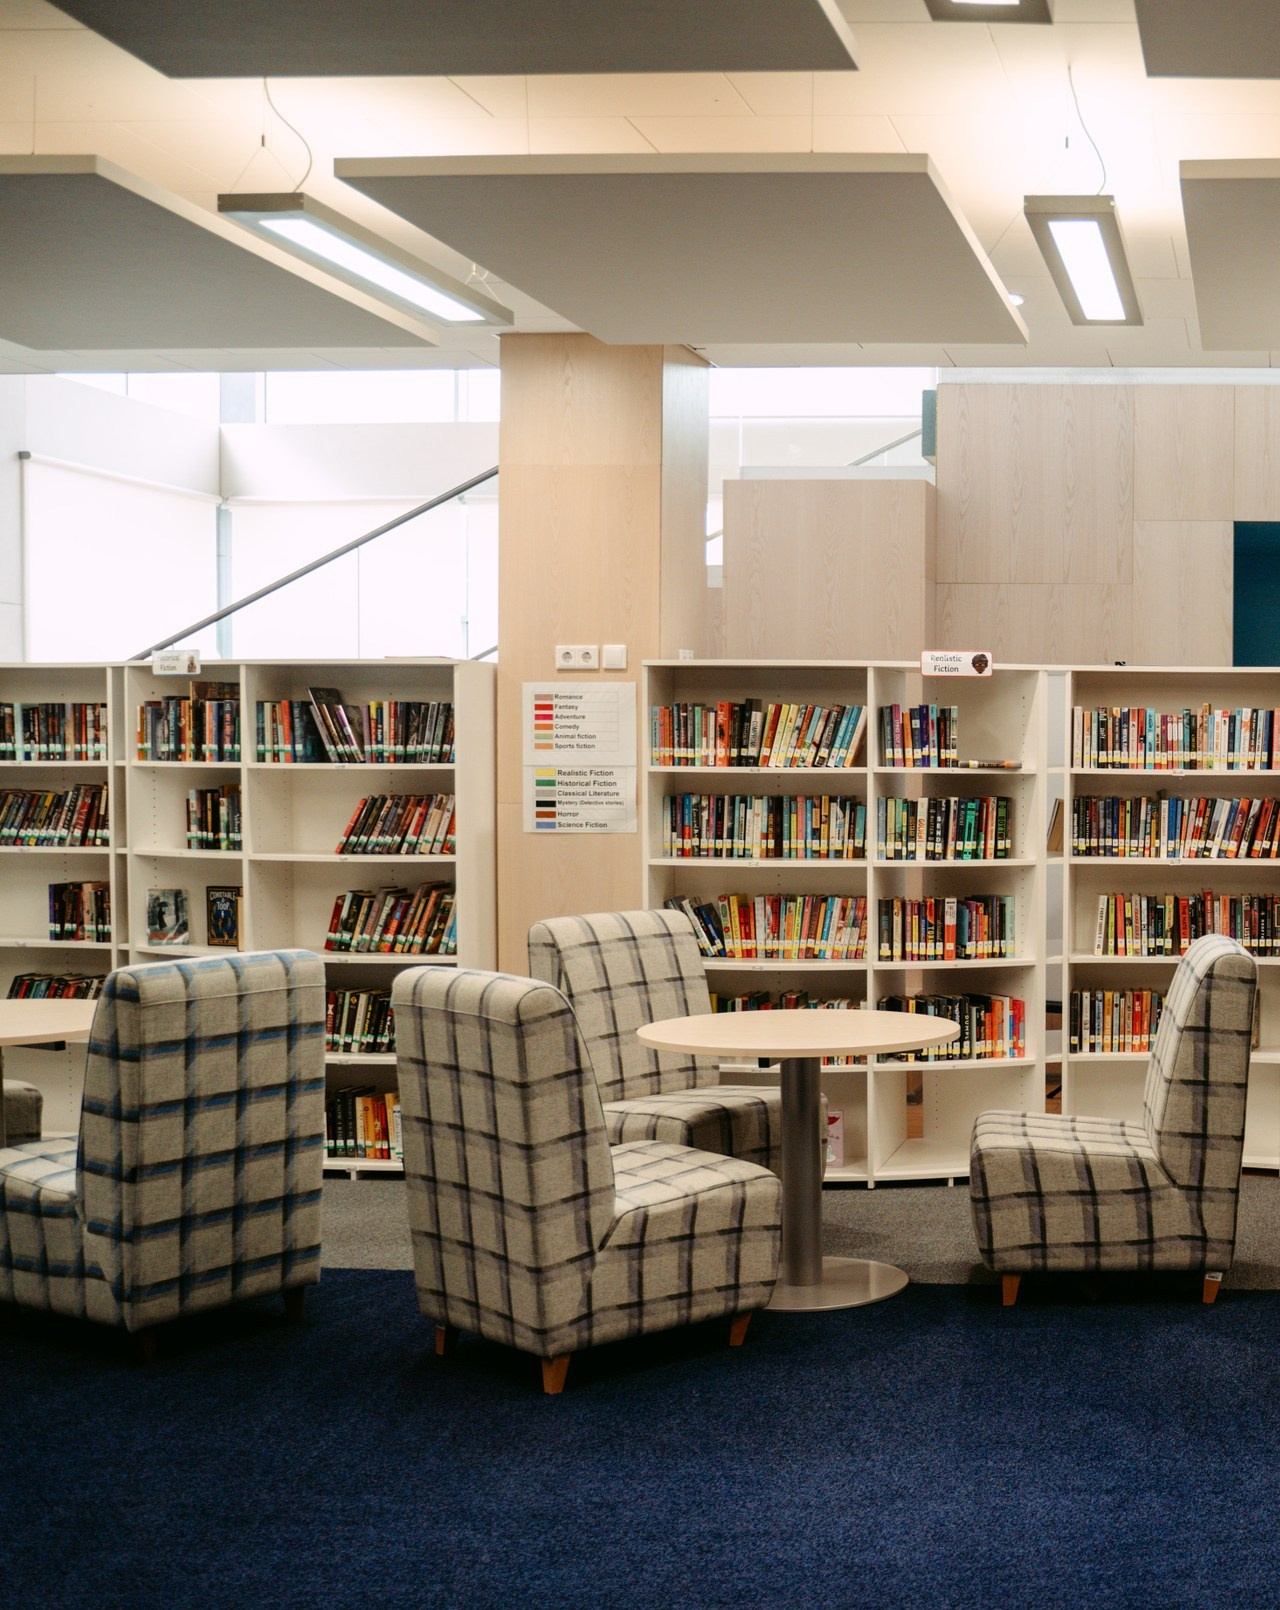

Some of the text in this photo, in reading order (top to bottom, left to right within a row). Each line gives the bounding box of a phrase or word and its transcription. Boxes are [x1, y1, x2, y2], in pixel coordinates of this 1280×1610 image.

[930, 654, 962, 662] Realistic
[933, 664, 959, 673] Fiction
[554, 703, 578, 711] Fantasy
